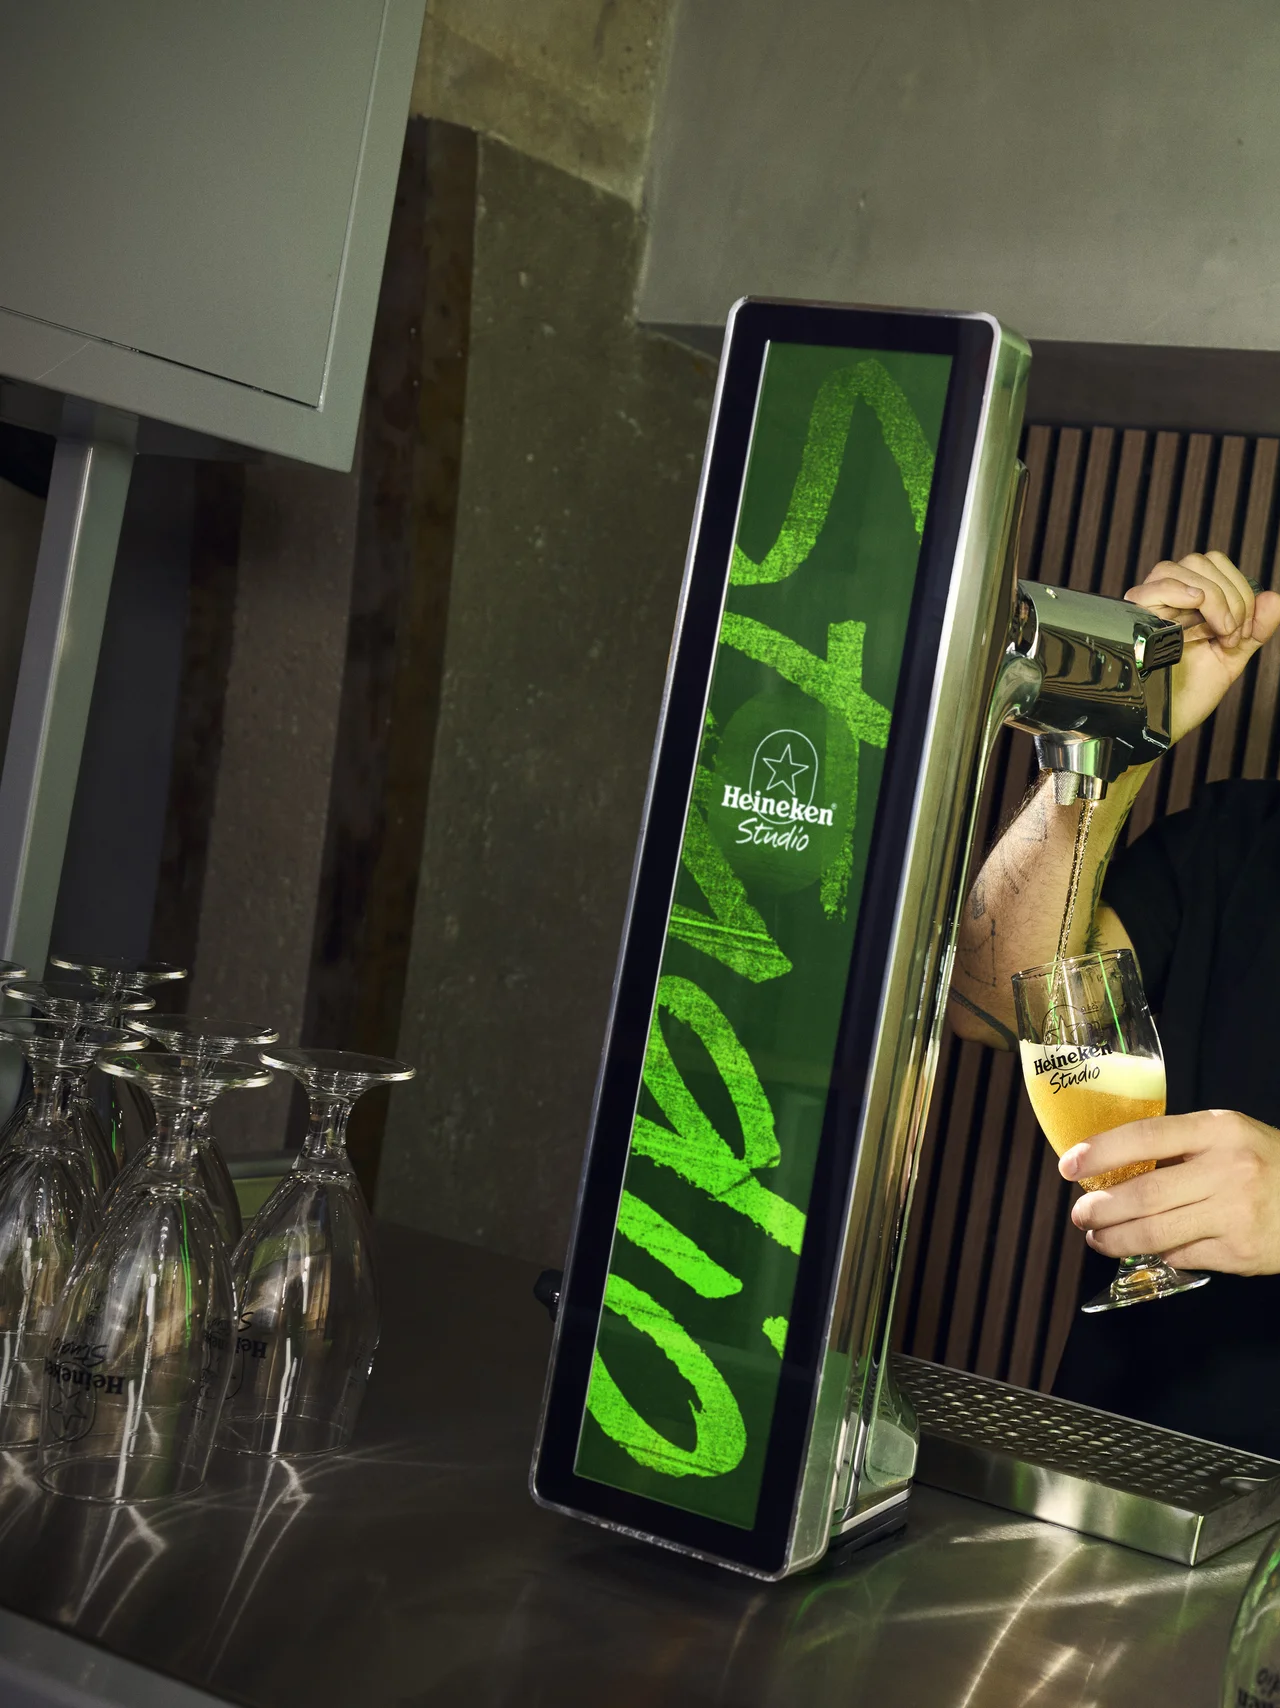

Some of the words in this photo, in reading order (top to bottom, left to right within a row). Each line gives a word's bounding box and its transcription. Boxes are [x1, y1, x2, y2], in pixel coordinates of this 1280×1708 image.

[721, 784, 834, 826] Heineken
[736, 818, 809, 851] Studio
[1034, 1043, 1113, 1076] Heineken
[1050, 1063, 1100, 1095] Studio
